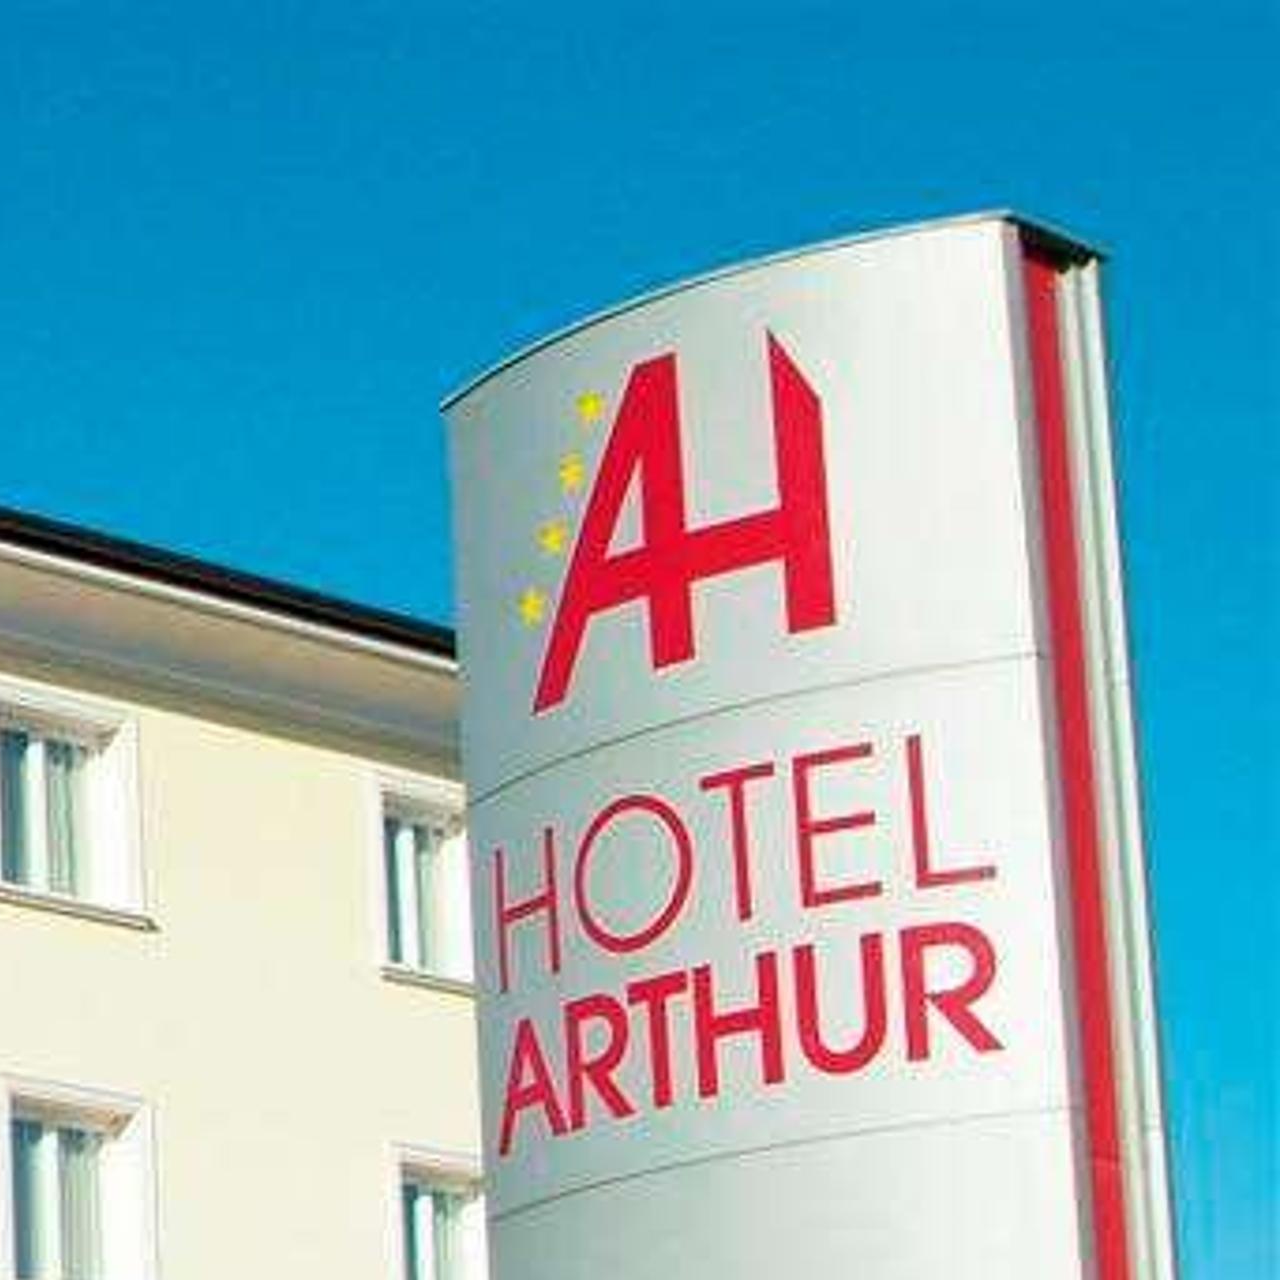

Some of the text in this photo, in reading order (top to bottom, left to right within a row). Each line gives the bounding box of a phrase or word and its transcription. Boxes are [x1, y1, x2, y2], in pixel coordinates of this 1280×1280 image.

[532, 328, 837, 714] AH
[493, 735, 997, 993] HOTEL
[498, 921, 1006, 1158] ARTHUR
